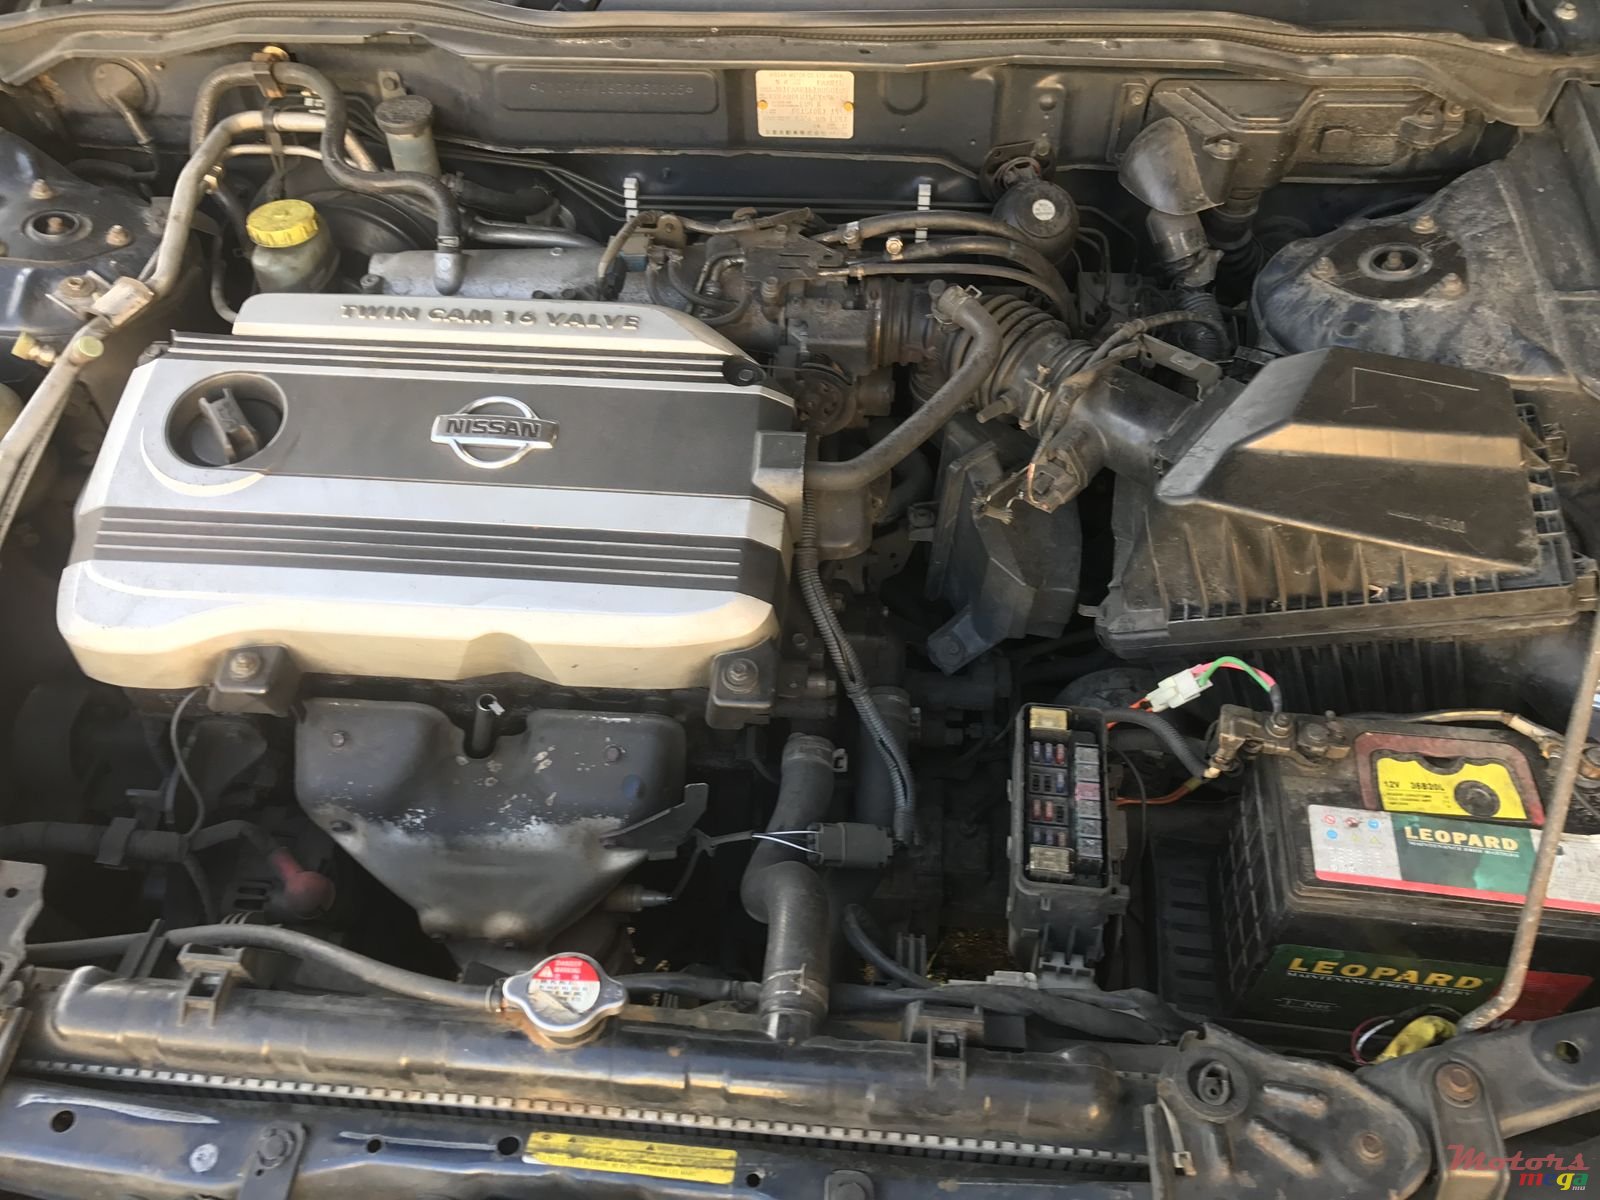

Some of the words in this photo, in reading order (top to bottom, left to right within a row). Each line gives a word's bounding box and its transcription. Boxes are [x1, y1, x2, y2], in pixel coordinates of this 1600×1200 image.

[340, 304, 420, 321] TWIN
[428, 307, 493, 324] CAM
[503, 310, 537, 325] 16
[546, 311, 641, 330] VALVE
[446, 418, 541, 437] NISSAN
[1404, 826, 1519, 852] LEOPARD
[1289, 958, 1484, 990] LEOPARD
